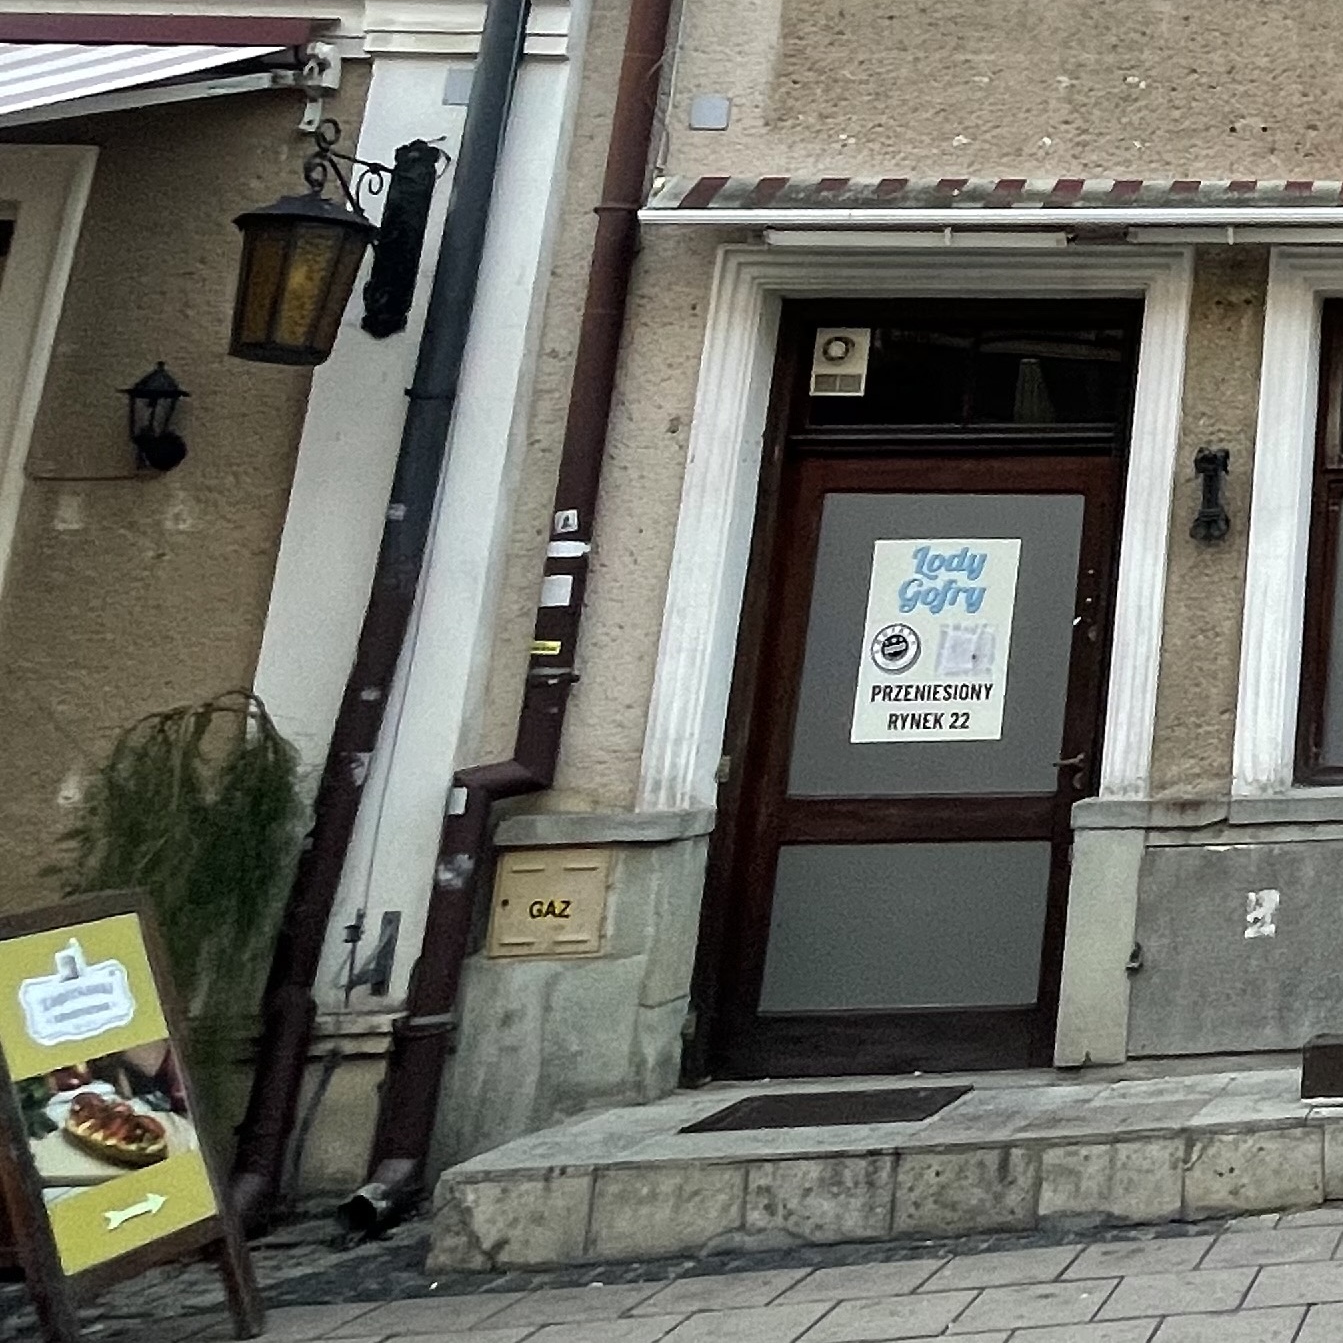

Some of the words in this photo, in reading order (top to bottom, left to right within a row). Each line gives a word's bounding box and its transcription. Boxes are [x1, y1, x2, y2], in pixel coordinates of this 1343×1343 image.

[912, 545, 987, 581] Lody
[898, 578, 987, 615] Gofry
[870, 683, 994, 703] PRZENIESIONY
[887, 712, 945, 731] RYNEK
[948, 712, 971, 730] 22
[529, 900, 571, 919] GAZ
